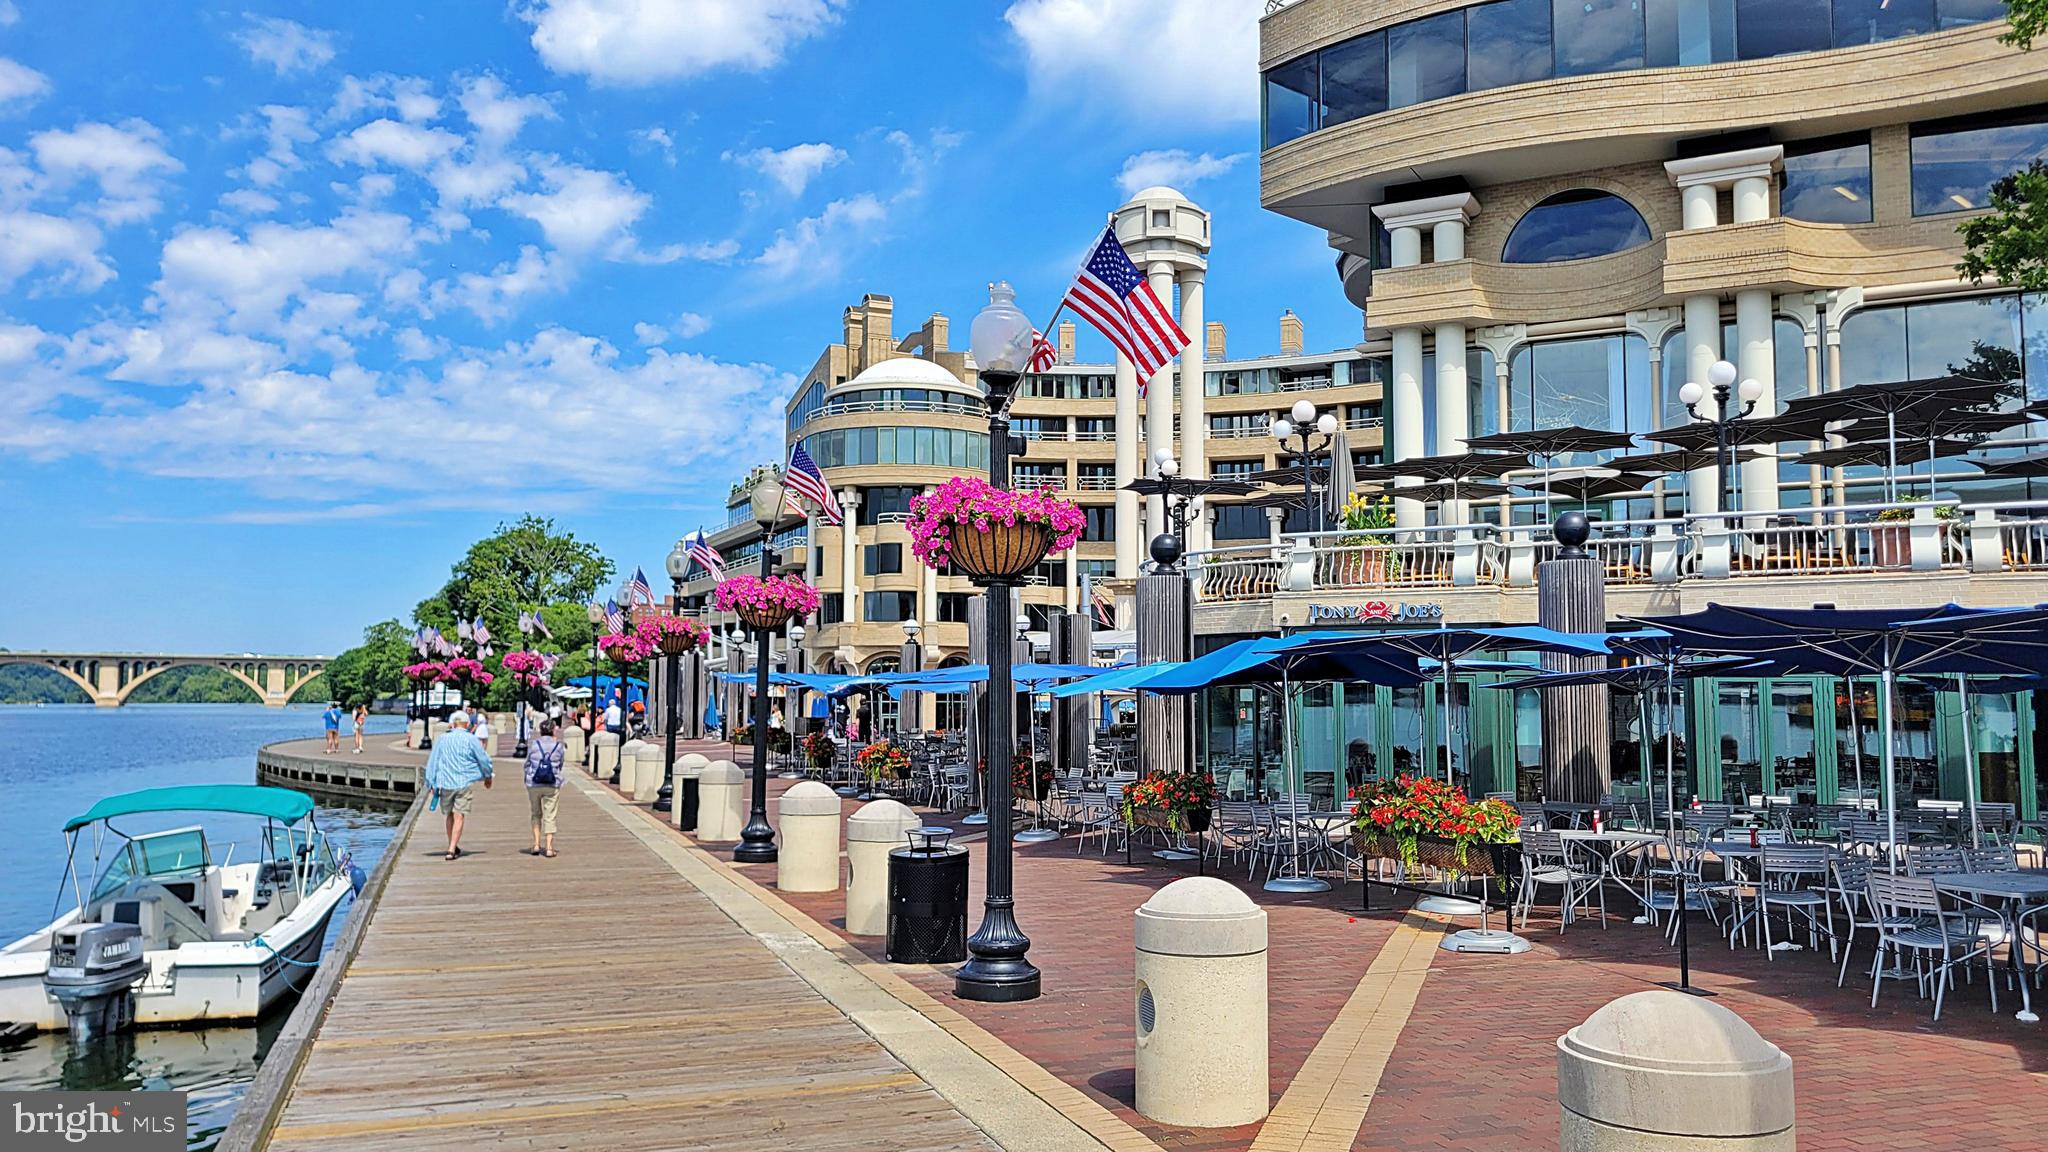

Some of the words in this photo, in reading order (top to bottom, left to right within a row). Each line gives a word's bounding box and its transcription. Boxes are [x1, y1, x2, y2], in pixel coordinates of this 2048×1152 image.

[1310, 603, 1357, 618] TONY
[1398, 602, 1441, 621] JOE'S
[103, 942, 131, 958] YAMAHA
